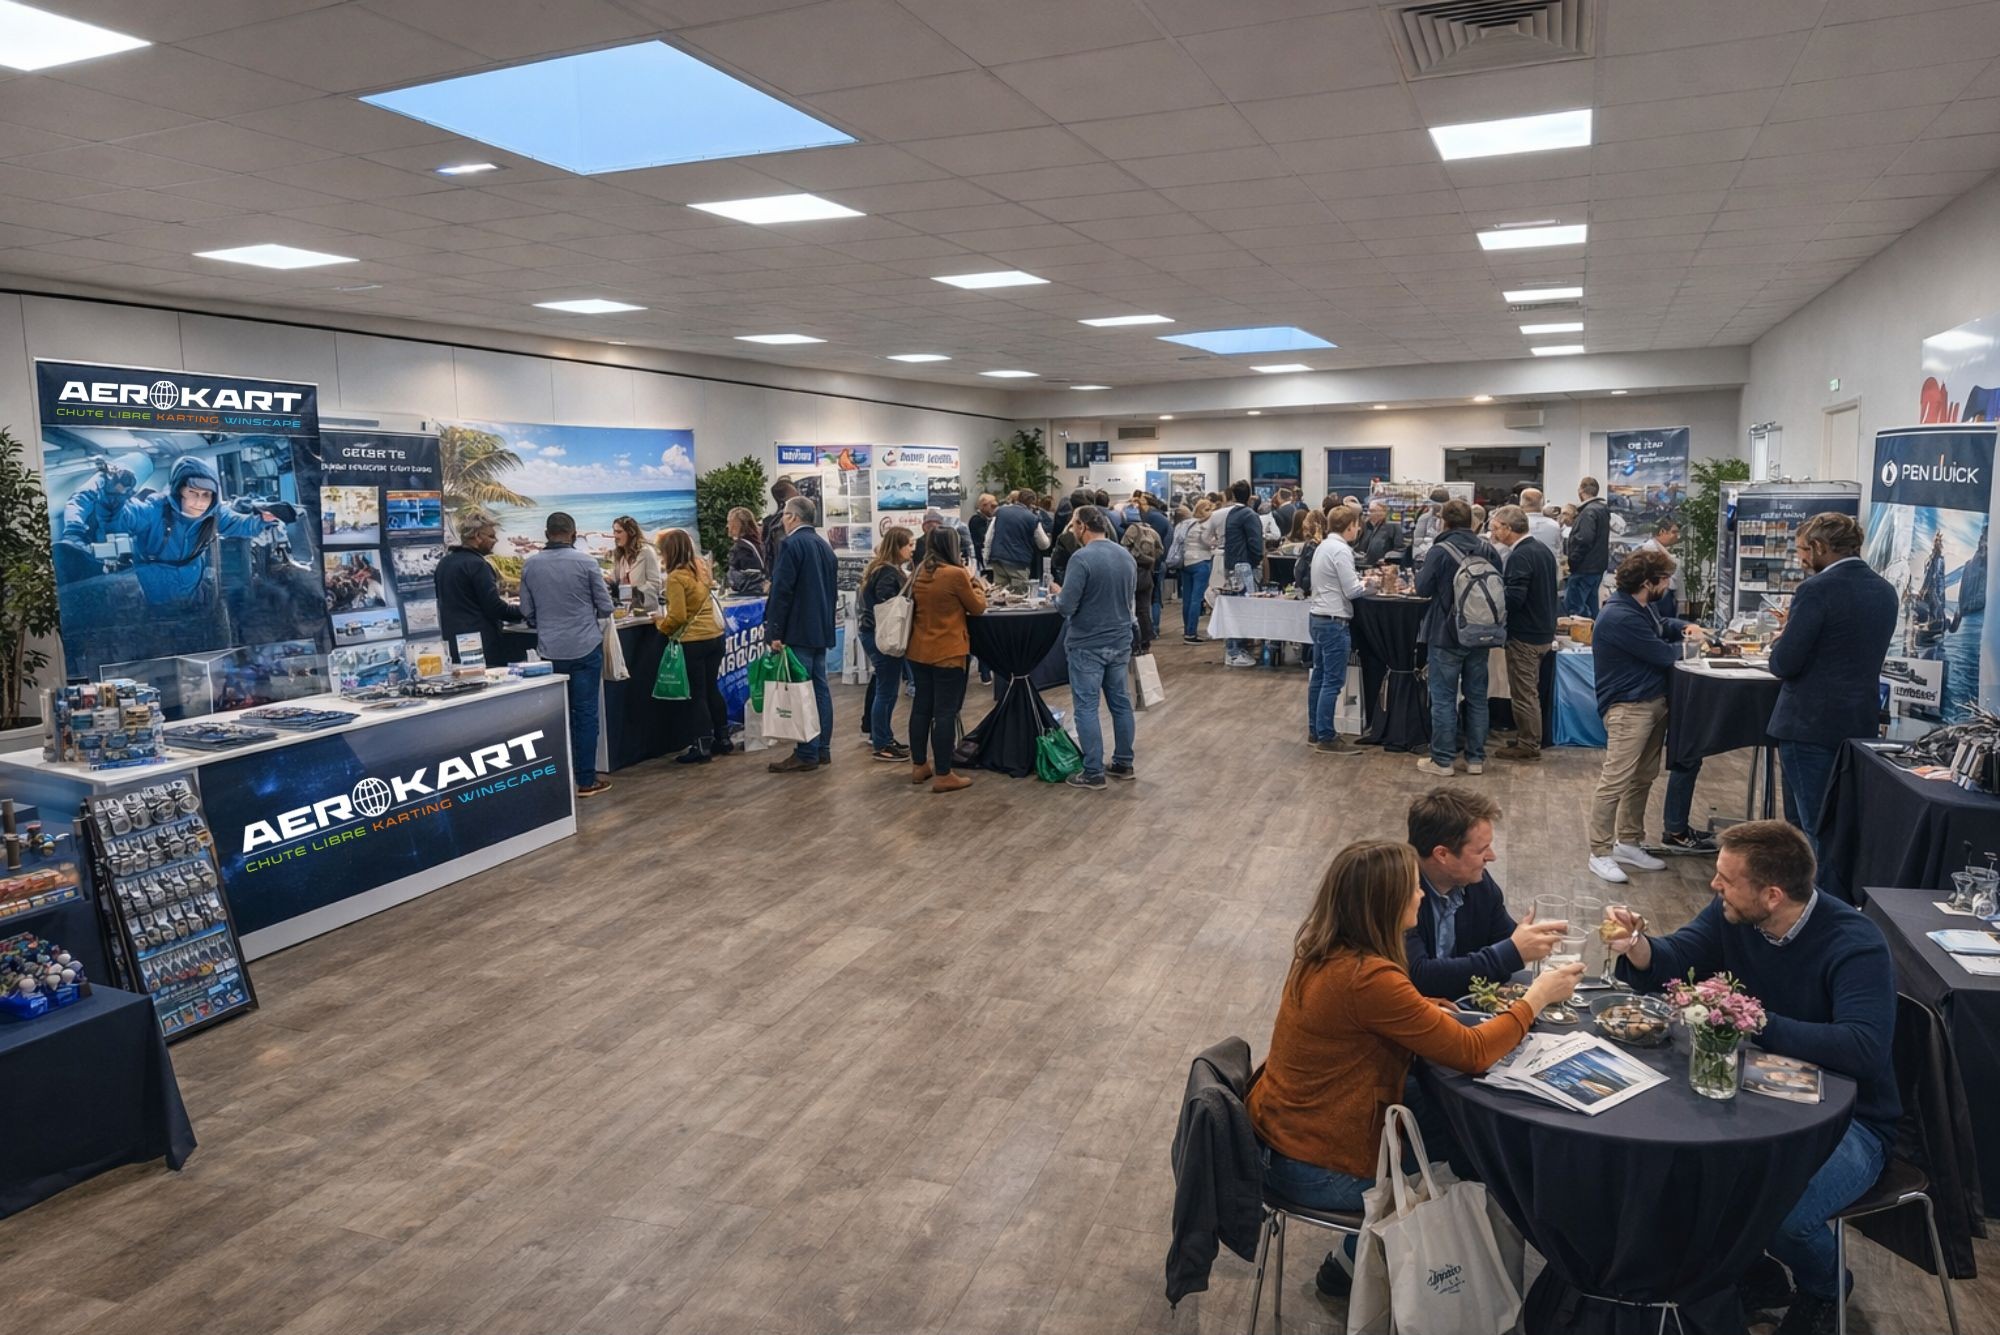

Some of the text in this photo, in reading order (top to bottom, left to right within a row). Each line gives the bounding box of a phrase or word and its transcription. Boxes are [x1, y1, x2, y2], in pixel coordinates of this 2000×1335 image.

[56, 408, 301, 428] CHUTE LIBRE KARTING WINSCAPE
[1901, 464, 1930, 481] PEN
[245, 764, 557, 873] CHUTE LIBRE KARTING WINSCAPE
